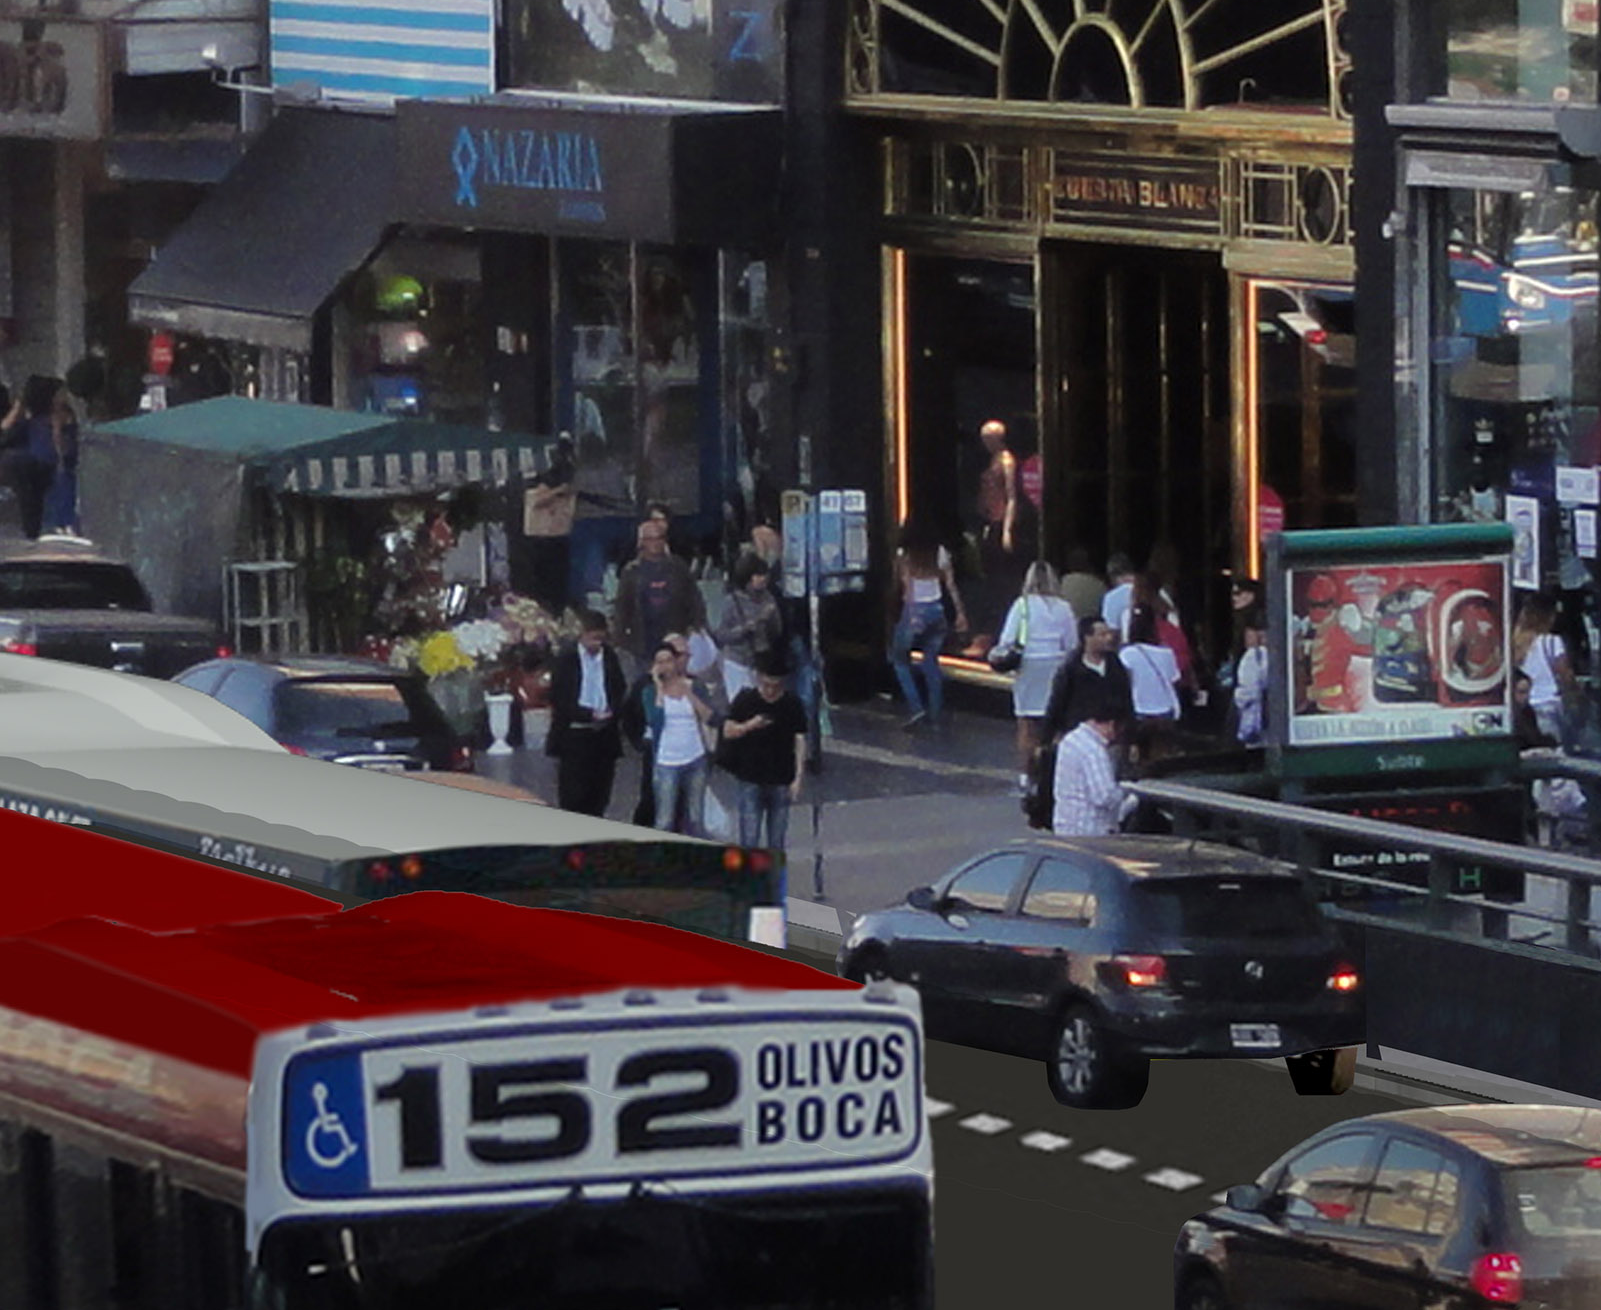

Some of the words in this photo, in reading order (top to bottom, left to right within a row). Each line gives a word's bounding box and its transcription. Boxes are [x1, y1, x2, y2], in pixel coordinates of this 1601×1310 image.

[483, 128, 603, 192] NAZARIA
[1458, 867, 1481, 888] H
[757, 1032, 905, 1092] OLIVOS
[373, 1045, 745, 1172] 152
[757, 1098, 903, 1147] BOCA
